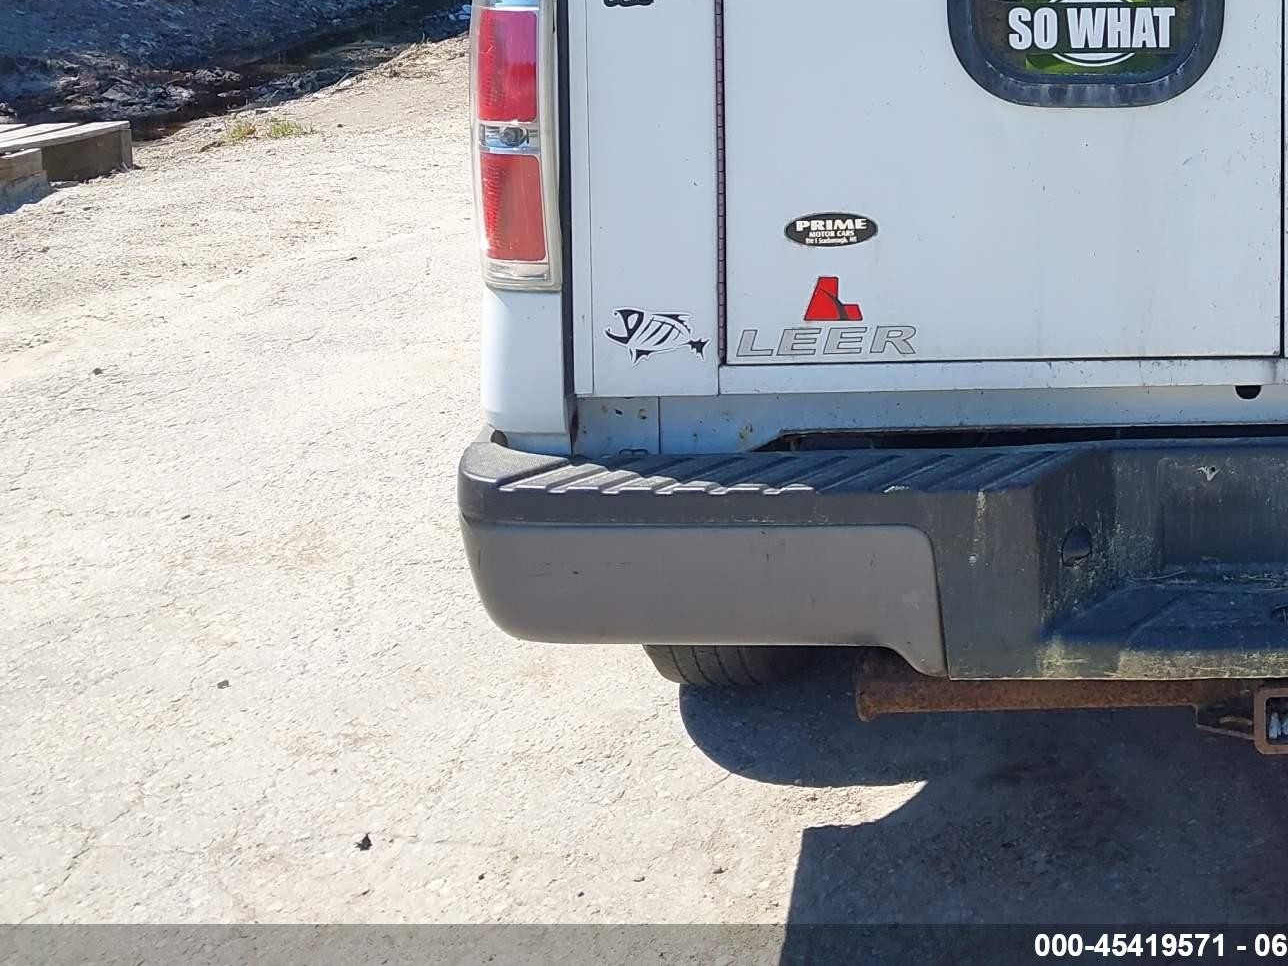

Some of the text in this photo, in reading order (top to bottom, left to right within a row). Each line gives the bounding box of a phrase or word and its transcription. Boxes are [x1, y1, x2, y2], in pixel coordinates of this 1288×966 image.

[1008, 7, 1176, 50] SO WHAT
[795, 218, 868, 232] PRIME
[736, 325, 917, 357] LEER
